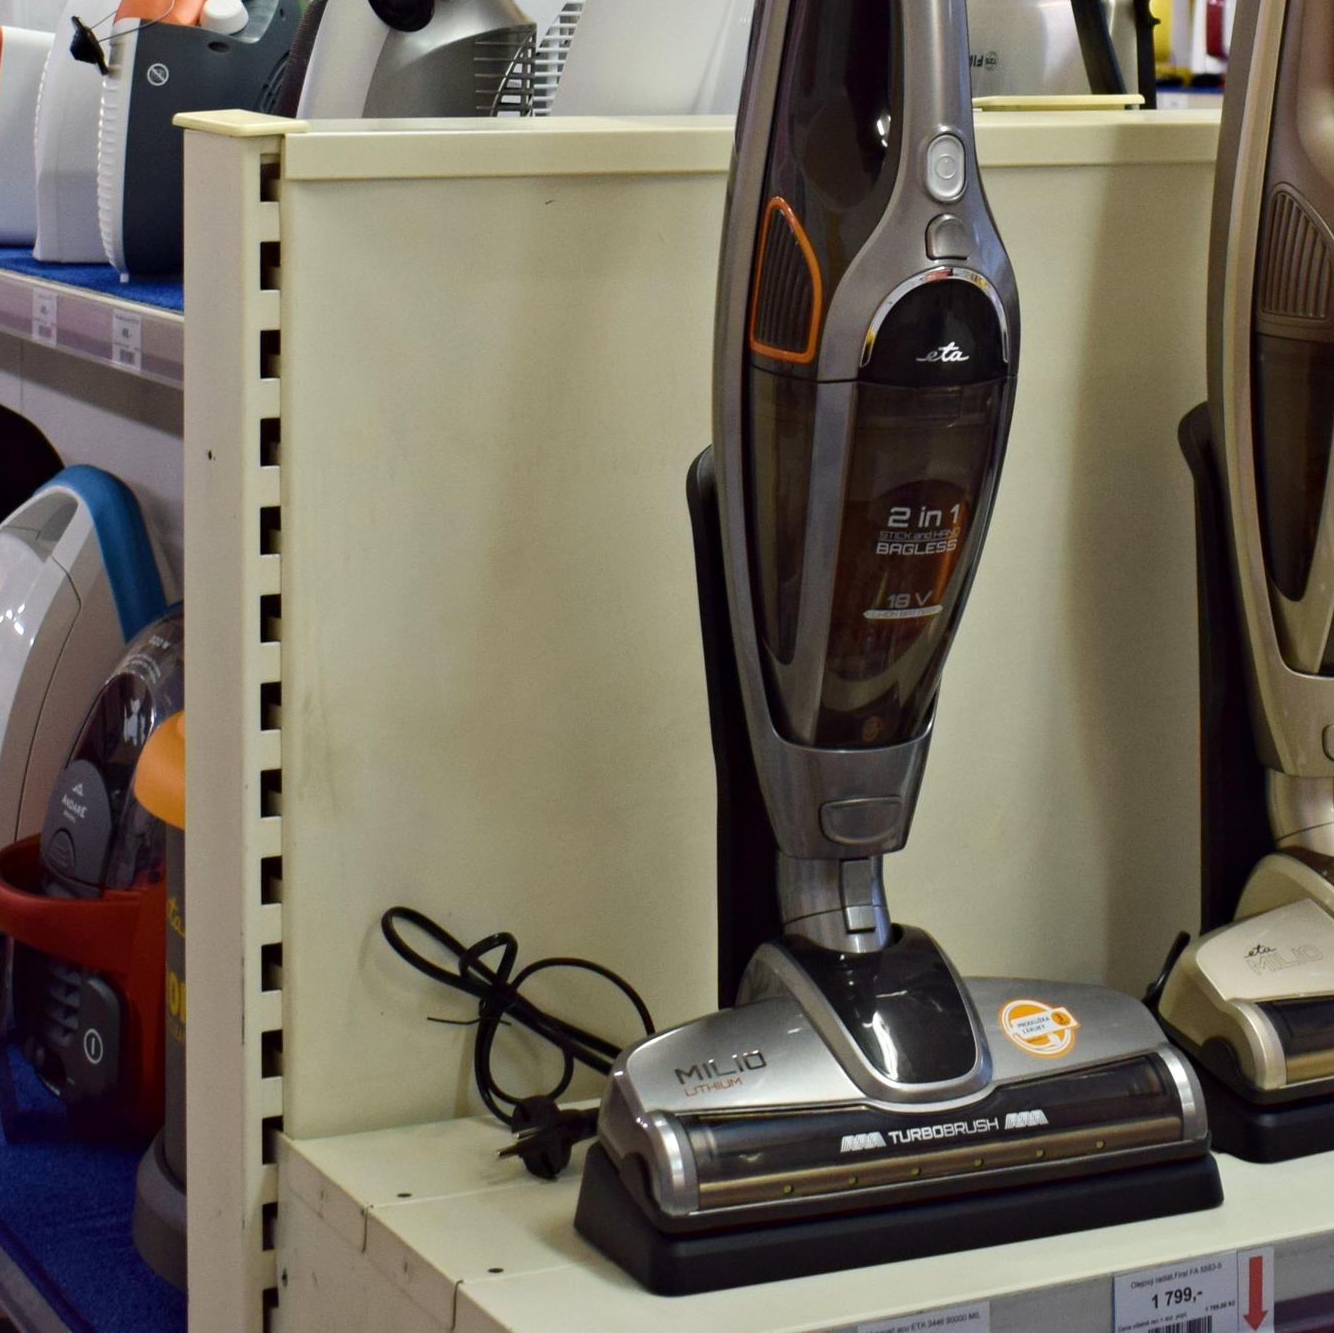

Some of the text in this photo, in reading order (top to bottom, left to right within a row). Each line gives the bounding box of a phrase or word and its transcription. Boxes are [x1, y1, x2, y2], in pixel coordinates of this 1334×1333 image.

[916, 341, 970, 365] eta
[887, 503, 962, 529] 2 in 1
[879, 530, 911, 541] STICK
[913, 529, 933, 540] and
[876, 538, 958, 556] BAGLESS
[887, 590, 933, 609] 18 V
[684, 1077, 746, 1098] LITHIUM
[887, 1117, 1000, 1146] TURBOBRUSH
[1151, 1285, 1204, 1310] 1 799,-
